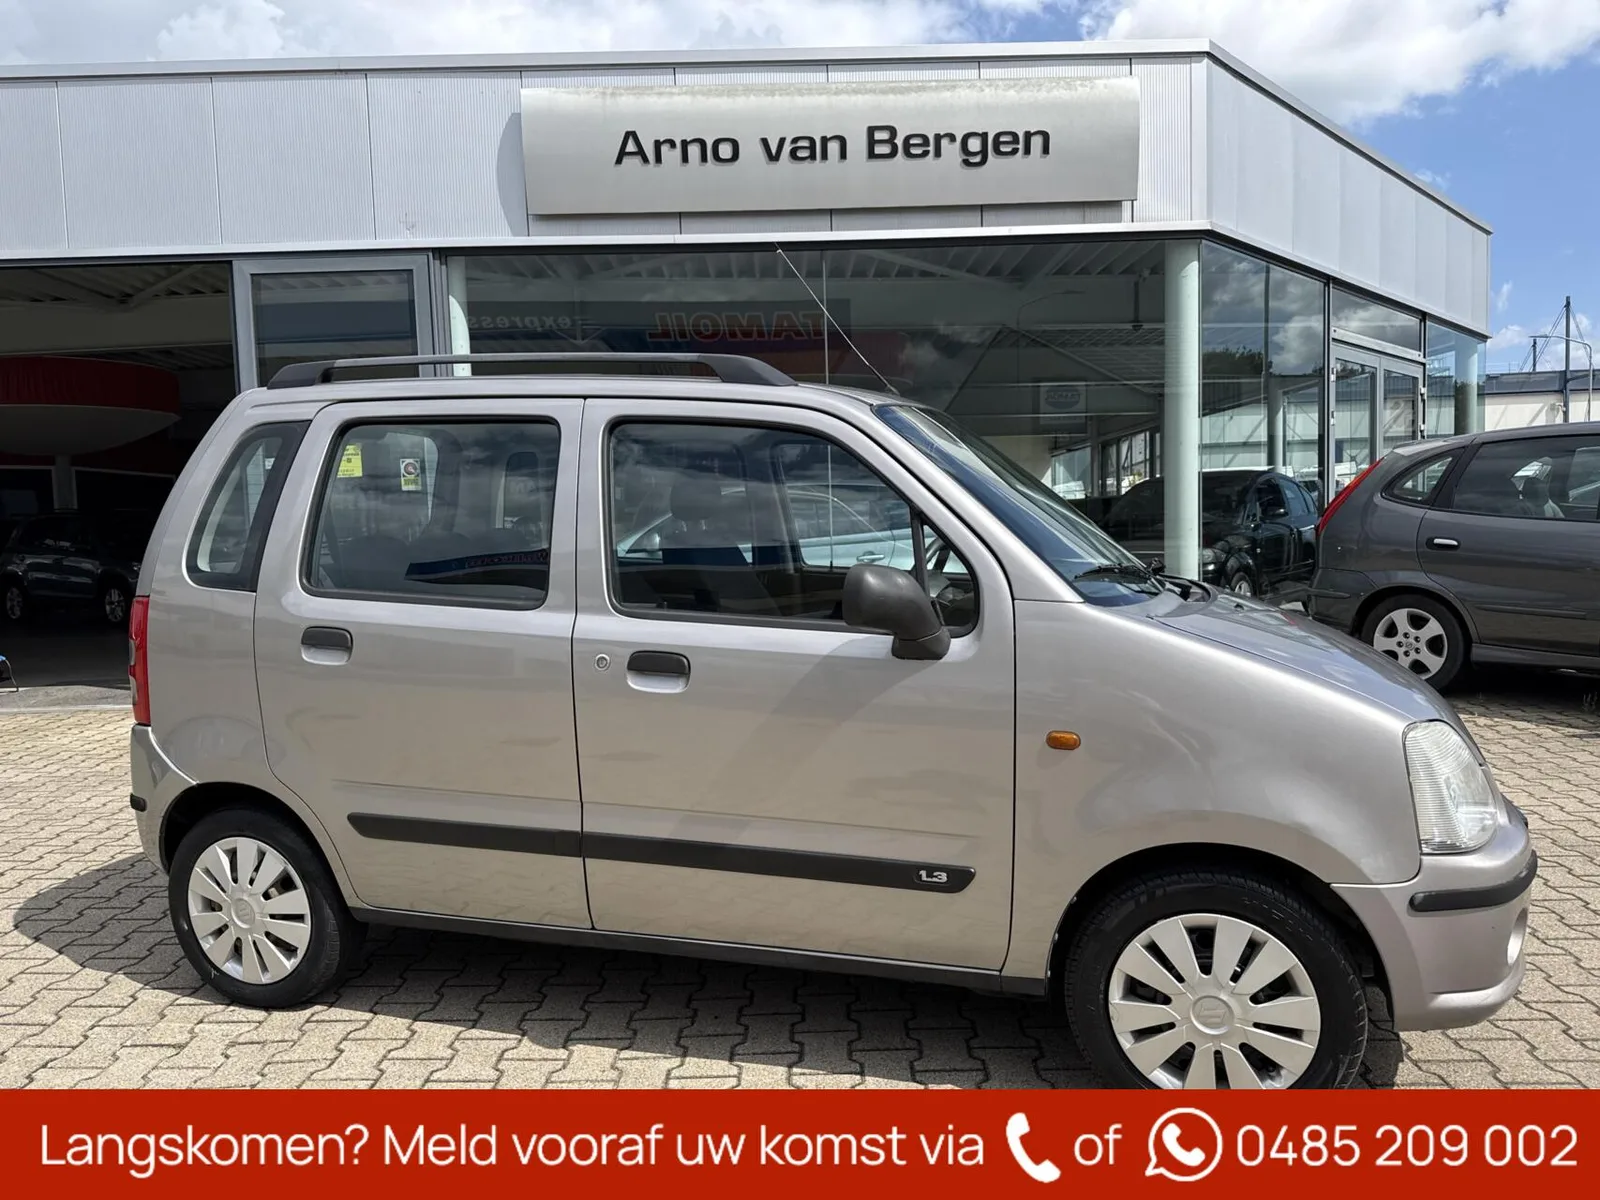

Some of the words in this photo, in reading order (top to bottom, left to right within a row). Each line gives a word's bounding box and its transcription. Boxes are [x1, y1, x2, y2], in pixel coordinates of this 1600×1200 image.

[614, 130, 740, 165] Arno
[760, 134, 847, 163] van
[867, 125, 1050, 168] Bergen
[919, 870, 948, 883] 1.3
